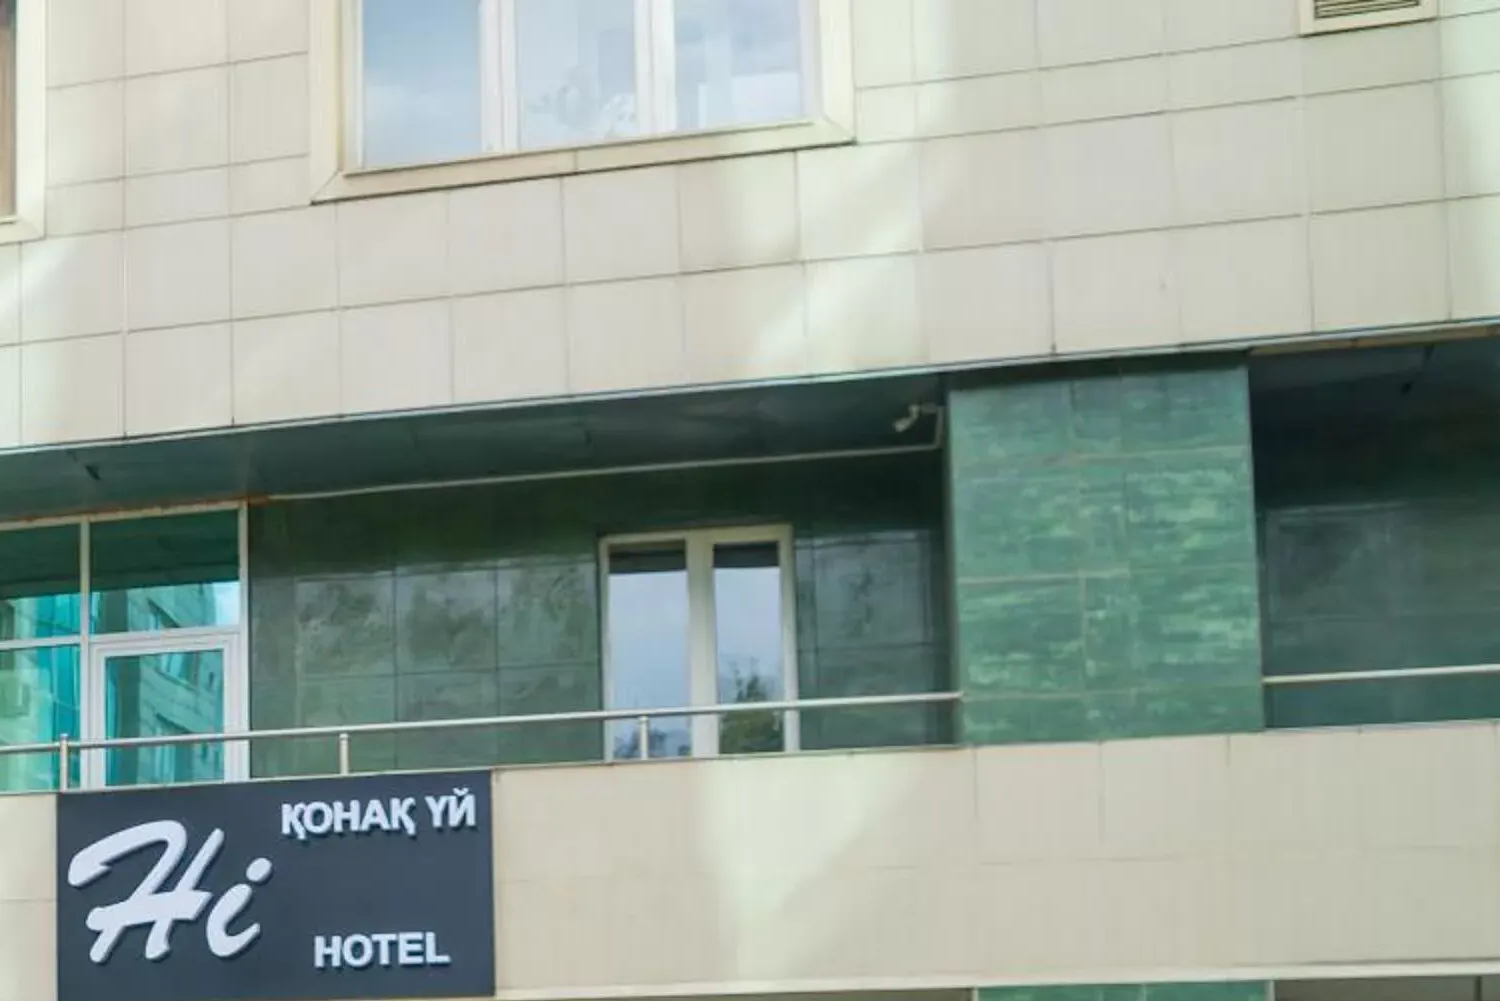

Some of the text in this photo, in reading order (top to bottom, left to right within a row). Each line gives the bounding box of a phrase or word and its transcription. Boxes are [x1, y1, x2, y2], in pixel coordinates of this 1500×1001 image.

[281, 787, 477, 840] ҚОНАҚ ҮЙ
[67, 819, 273, 964] Hi
[314, 931, 451, 968] HOTEL
